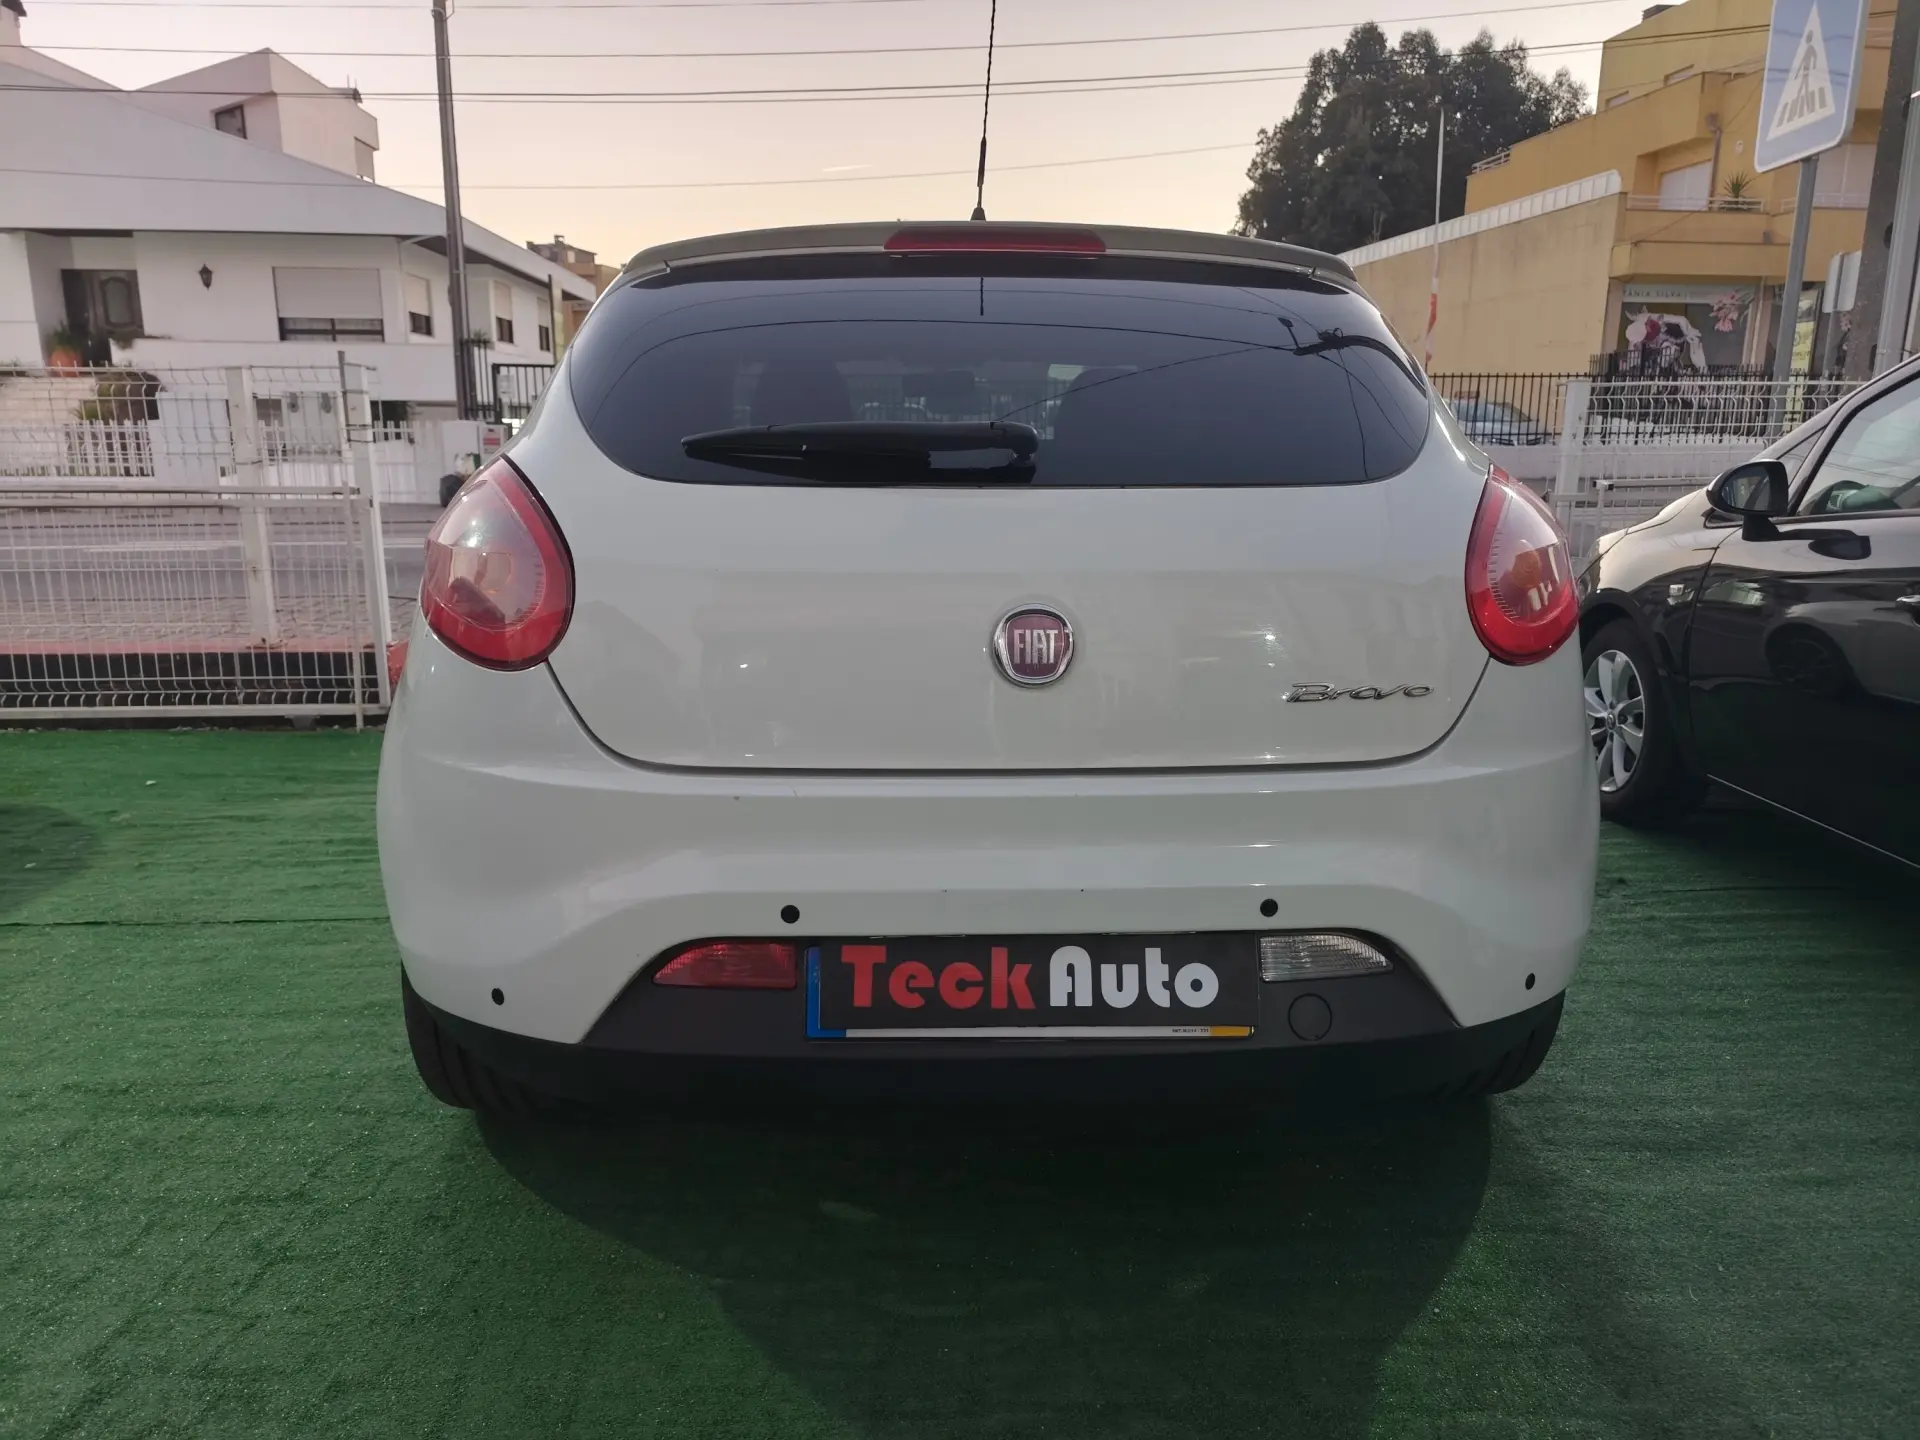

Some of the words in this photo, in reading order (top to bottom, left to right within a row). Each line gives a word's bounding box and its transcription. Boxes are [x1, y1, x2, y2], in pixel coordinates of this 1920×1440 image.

[1013, 629, 1059, 665] FIAT
[1286, 681, 1434, 703] Bravo
[841, 945, 1036, 1009] Teck
[1050, 945, 1219, 1009] Auto
